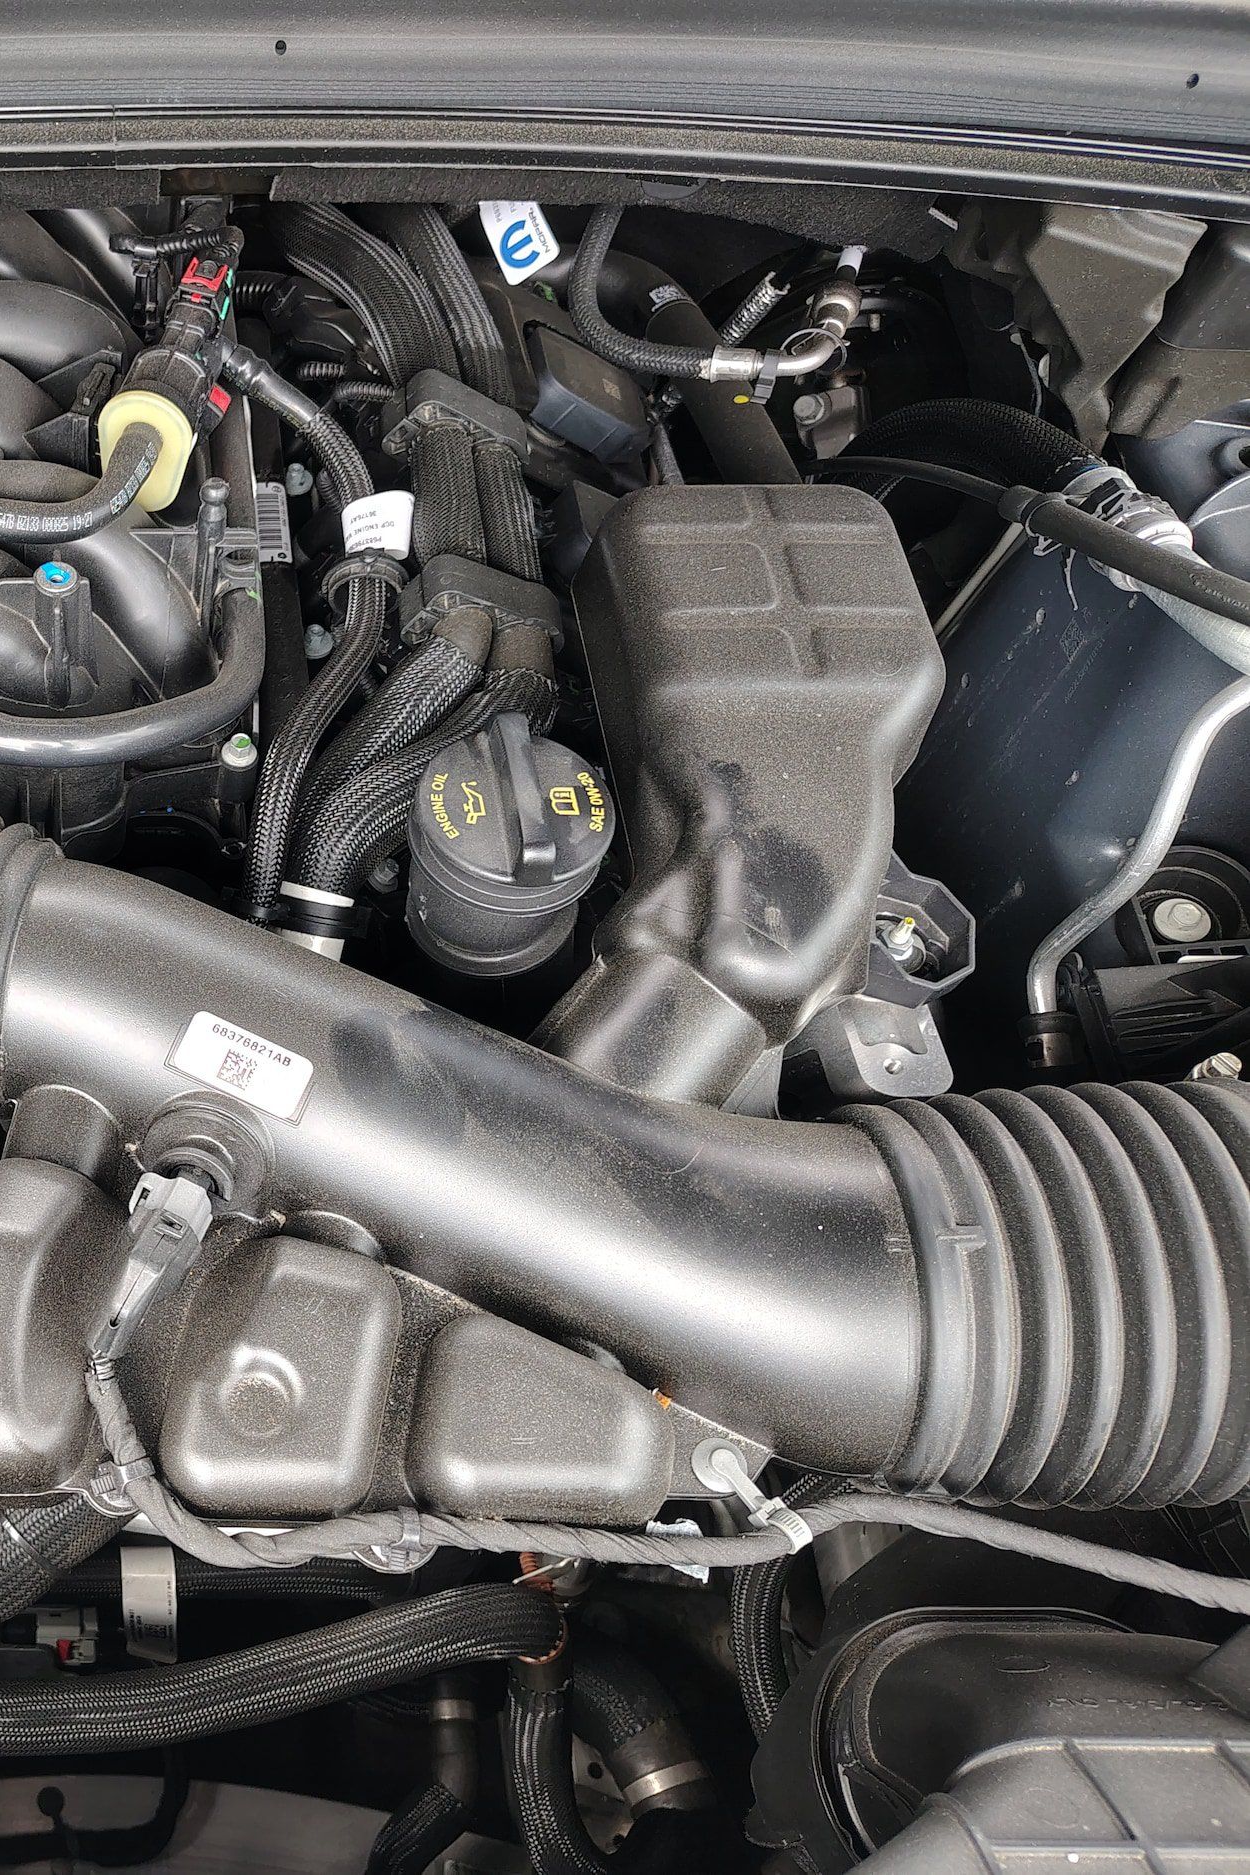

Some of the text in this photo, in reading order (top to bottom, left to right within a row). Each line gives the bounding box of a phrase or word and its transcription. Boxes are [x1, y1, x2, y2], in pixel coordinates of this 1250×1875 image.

[353, 523, 378, 536] ENGINE
[430, 772, 460, 840] ENGINE OIL
[577, 771, 606, 833] SAE 0W-20
[211, 1023, 292, 1067] 68376821AB
